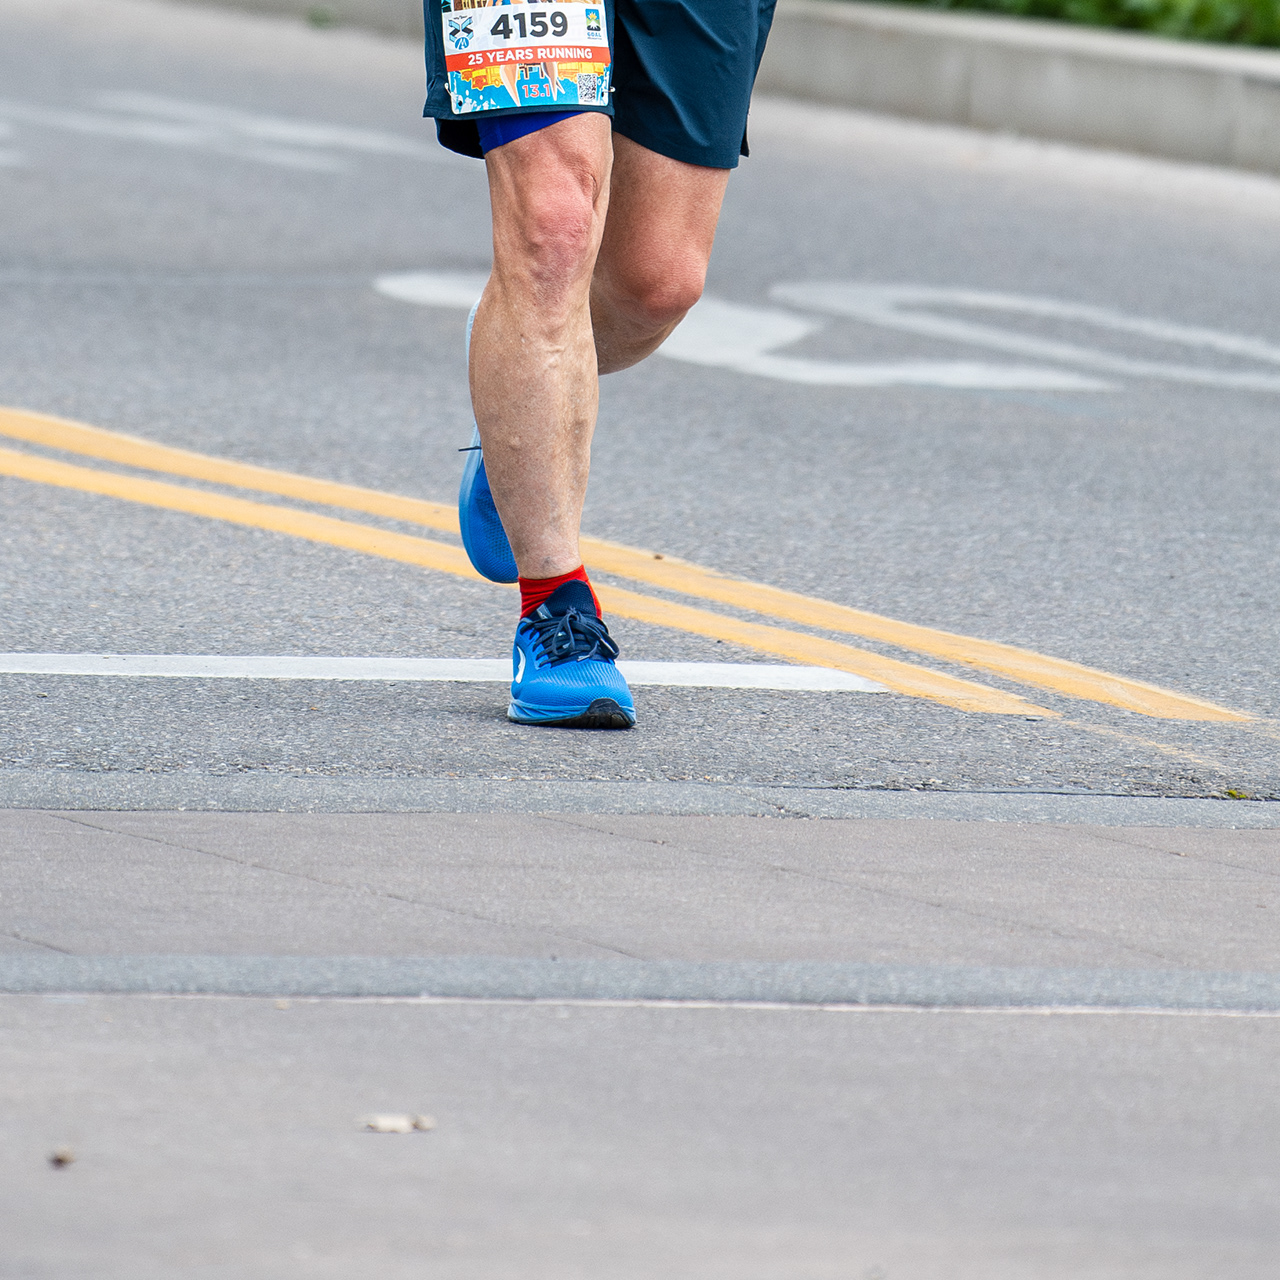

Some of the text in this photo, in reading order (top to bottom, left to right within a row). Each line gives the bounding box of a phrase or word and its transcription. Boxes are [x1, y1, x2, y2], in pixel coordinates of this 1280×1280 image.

[490, 11, 568, 39] 4159
[468, 48, 593, 66] 25 YEARS RUNNING
[522, 83, 551, 98] 13.1
